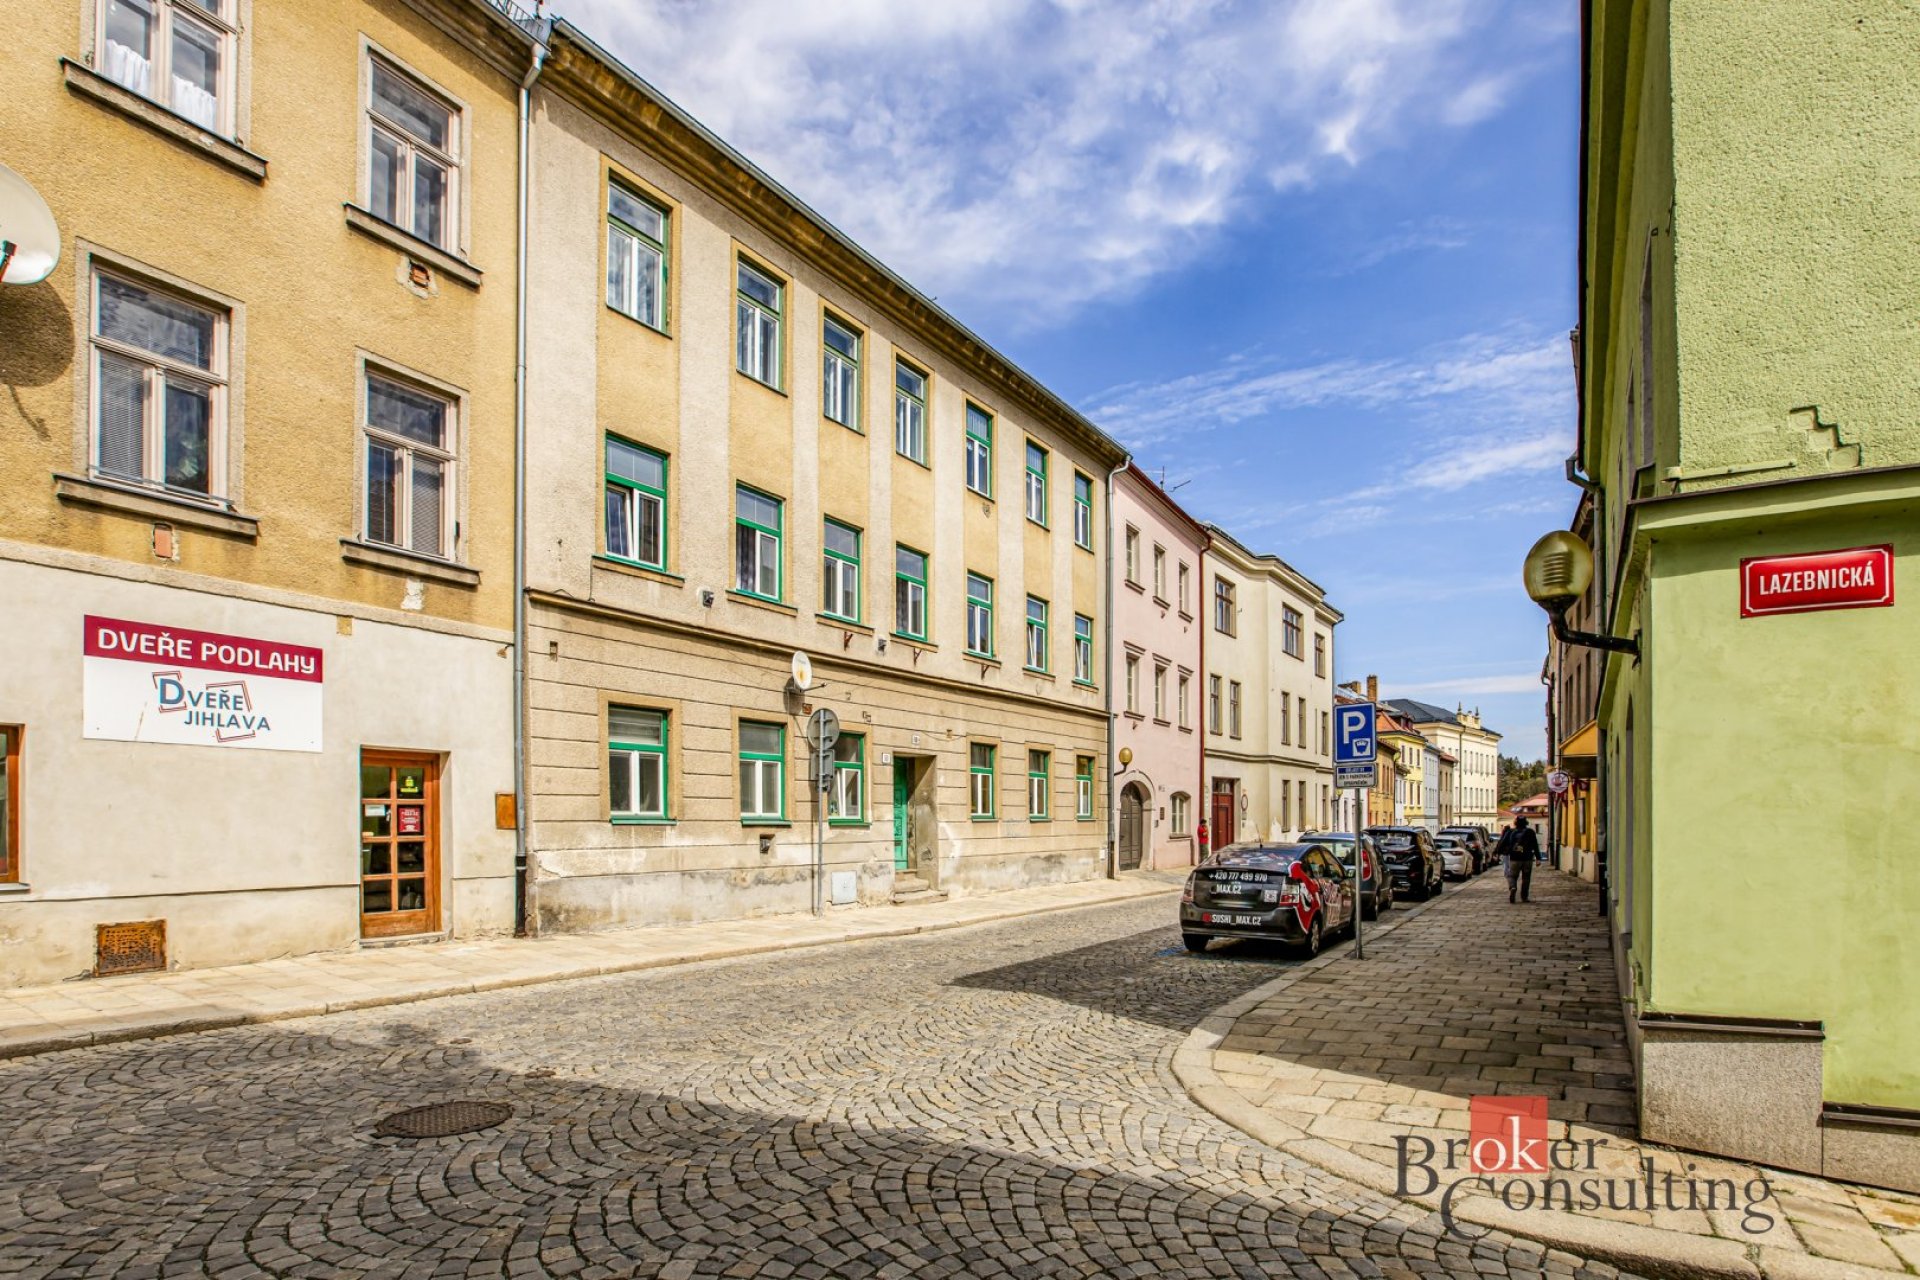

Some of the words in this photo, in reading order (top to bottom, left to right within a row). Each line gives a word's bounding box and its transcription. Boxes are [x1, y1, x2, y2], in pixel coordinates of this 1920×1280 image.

[1760, 560, 1875, 596] LAZEBNICKÁ
[97, 628, 192, 660] DVEŘE
[201, 641, 316, 674] PODLAHY
[159, 677, 244, 711] DVEŘE
[184, 710, 271, 731] JIHLAVA
[1342, 711, 1366, 745] P
[1229, 872, 1240, 880] 777
[1211, 914, 1262, 926] SUSHI_MAX.CZ
